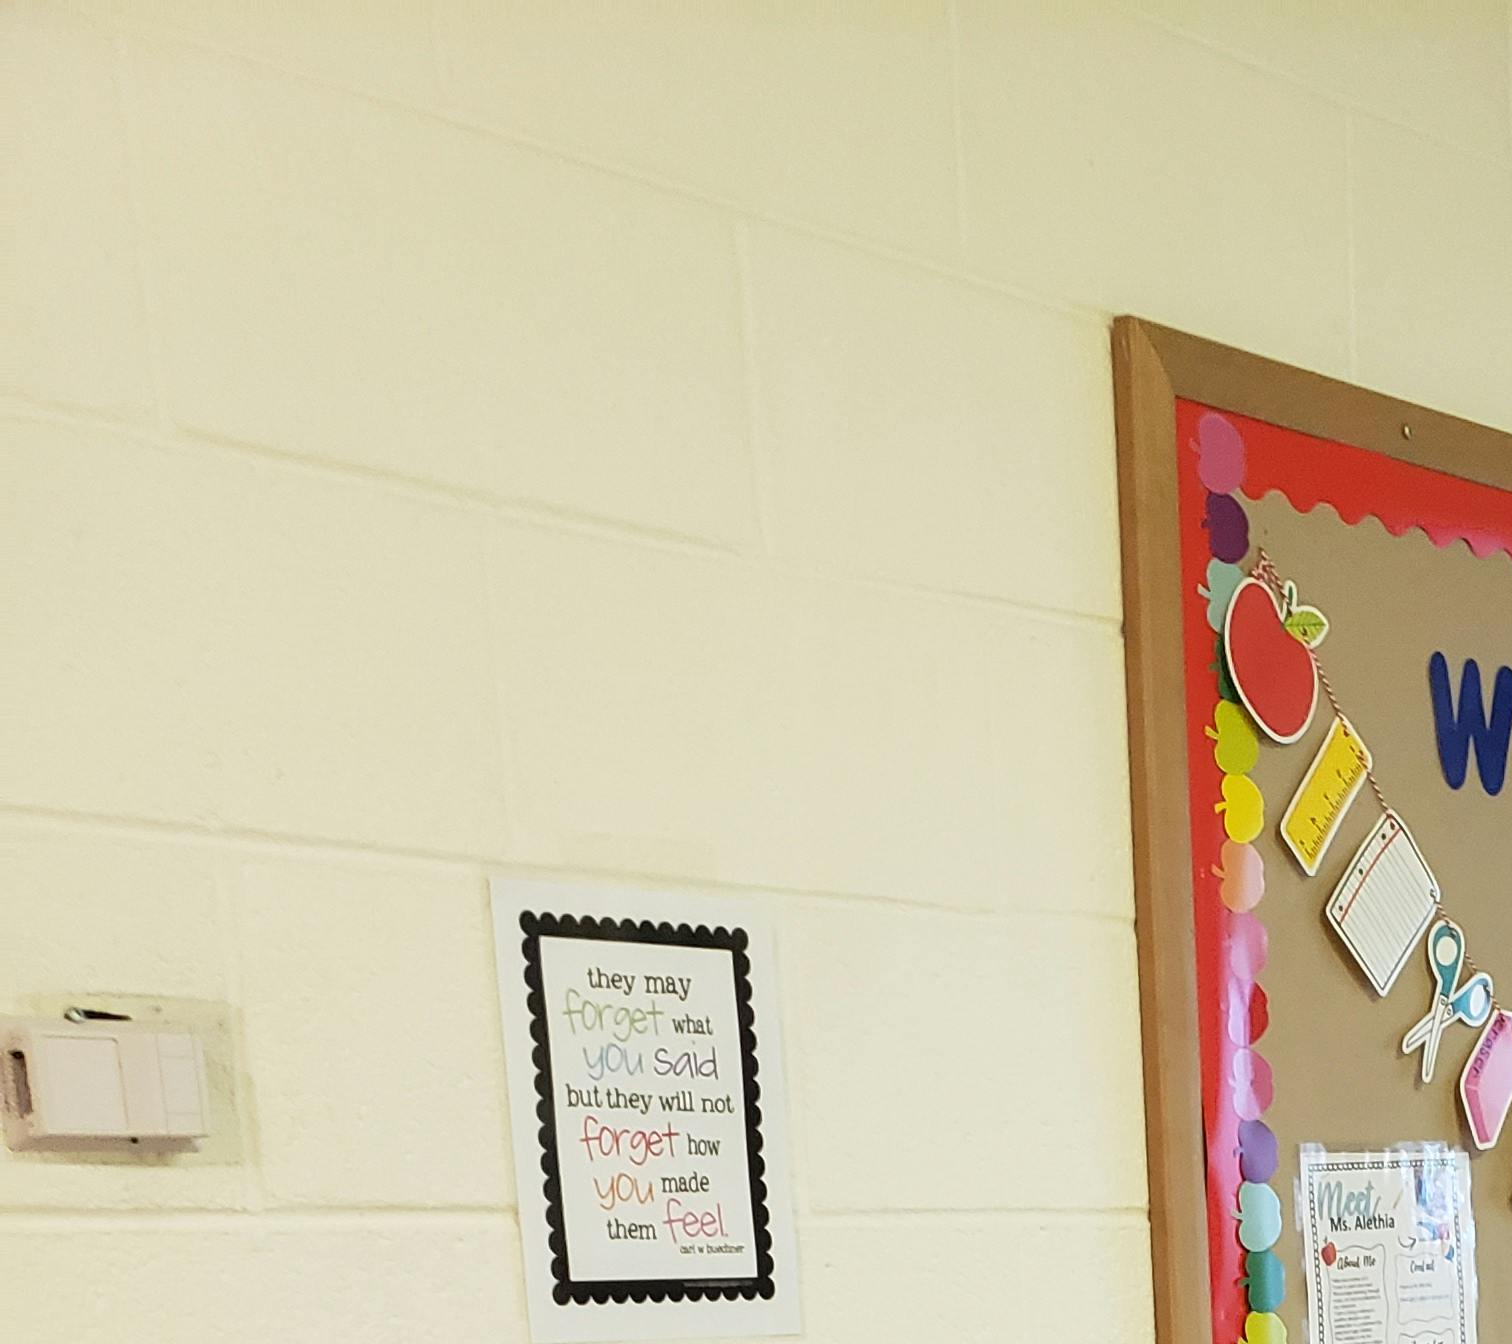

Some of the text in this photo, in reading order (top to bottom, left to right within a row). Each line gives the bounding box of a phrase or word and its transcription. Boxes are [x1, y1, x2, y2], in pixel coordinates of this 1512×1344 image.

[587, 967, 692, 1000] they may
[563, 988, 714, 1042] forget what
[581, 1041, 719, 1081] you said
[565, 1083, 735, 1115] but they will not
[580, 1115, 721, 1165] forget how
[593, 1171, 710, 1211] you made
[1316, 1179, 1375, 1221] Meet
[606, 1198, 729, 1243] them feel.
[1330, 1213, 1396, 1232] Ms. Alethia
